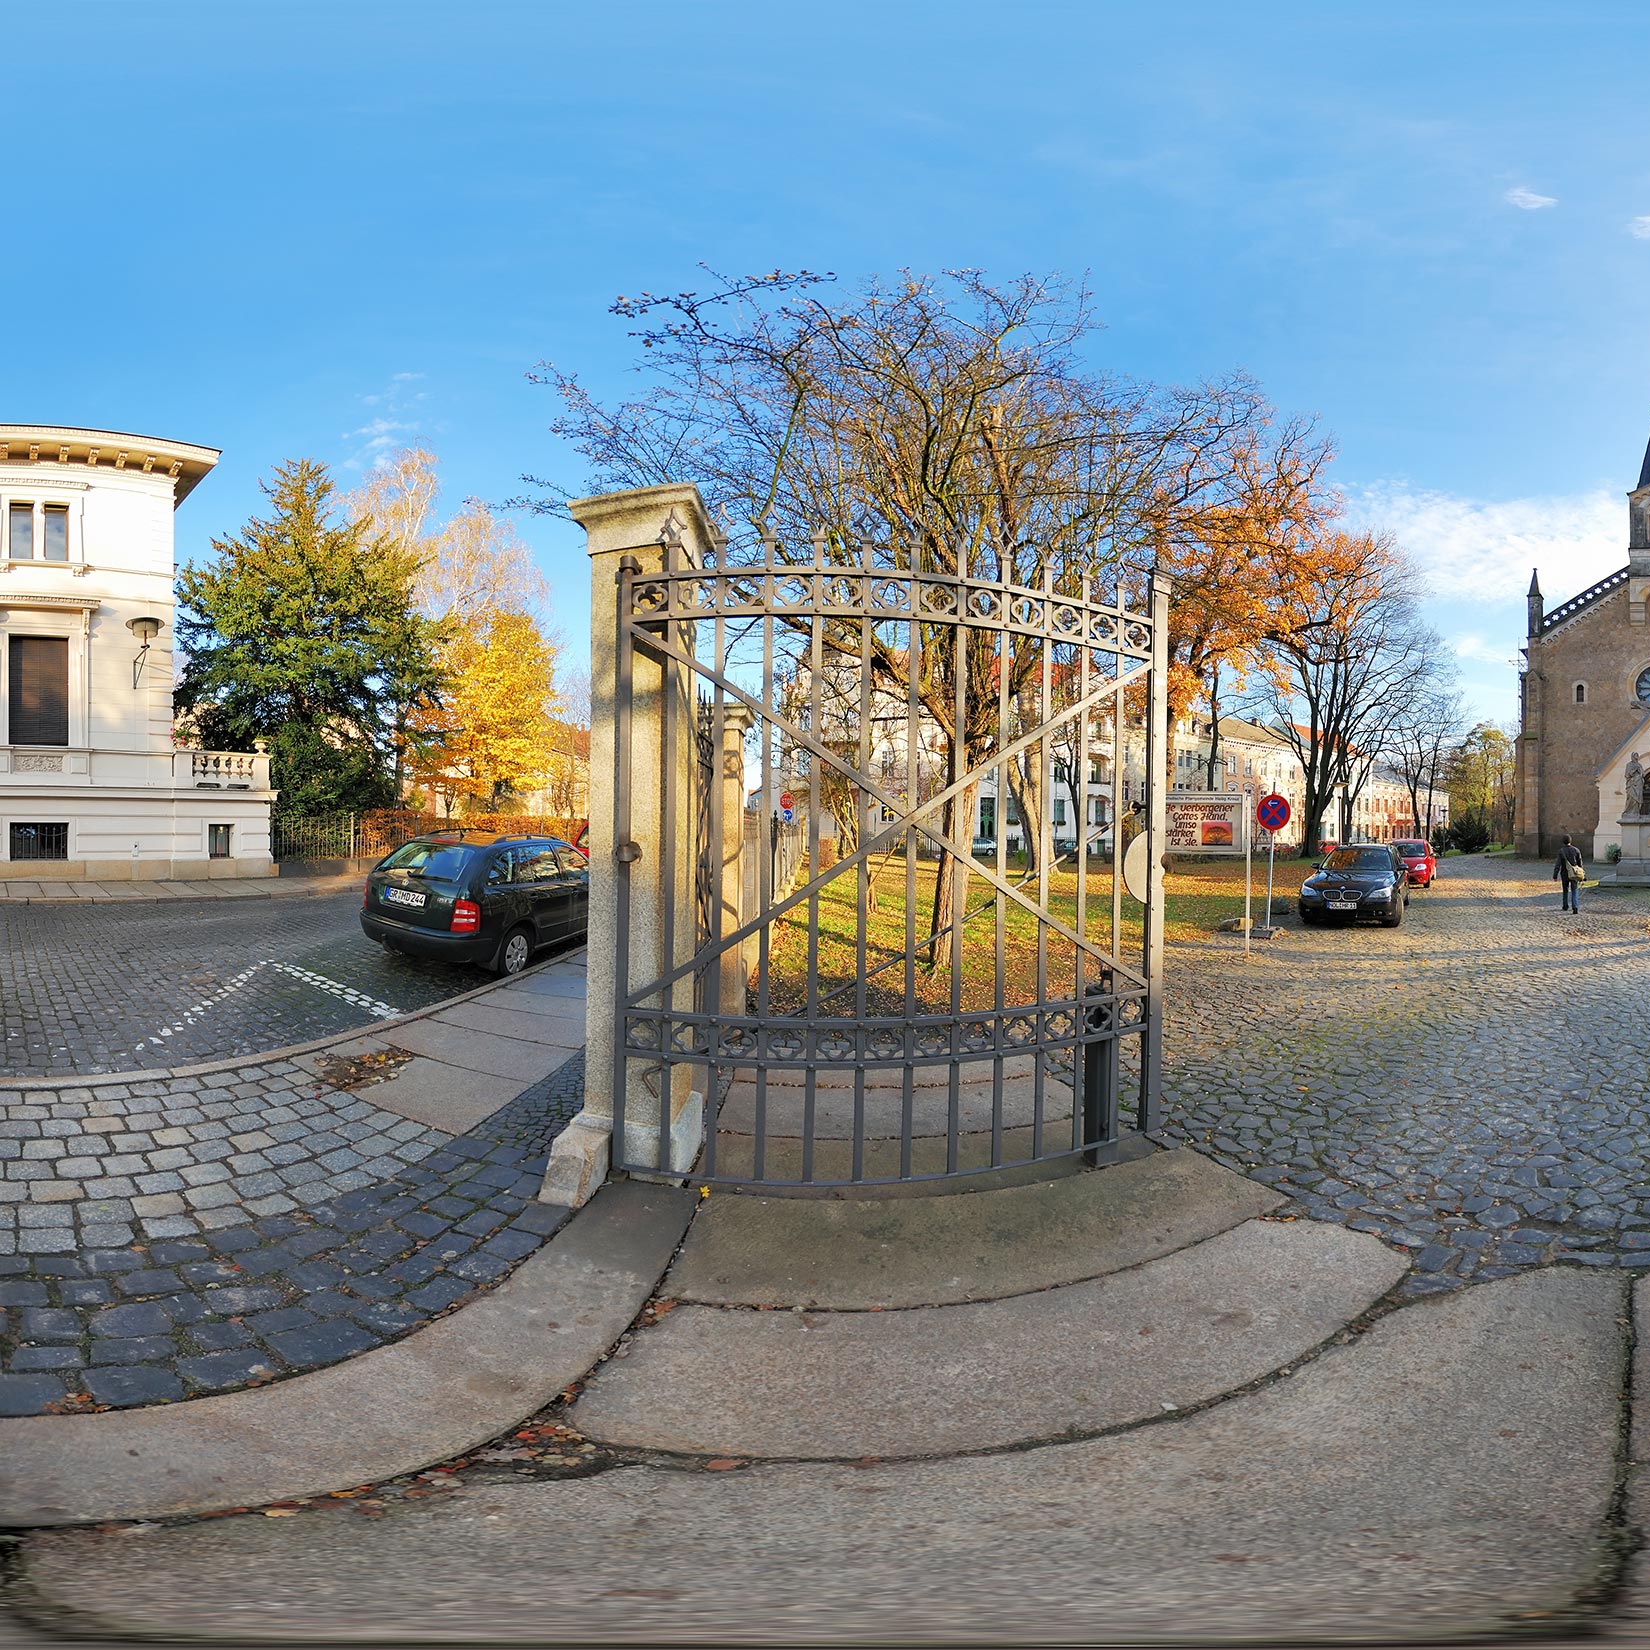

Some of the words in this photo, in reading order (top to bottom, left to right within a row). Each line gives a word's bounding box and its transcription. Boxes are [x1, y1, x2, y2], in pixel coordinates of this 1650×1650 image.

[1180, 803, 1234, 814] verborgener
[1172, 812, 1199, 822] Gottes
[389, 889, 398, 898] GR
[411, 894, 424, 904] 244
